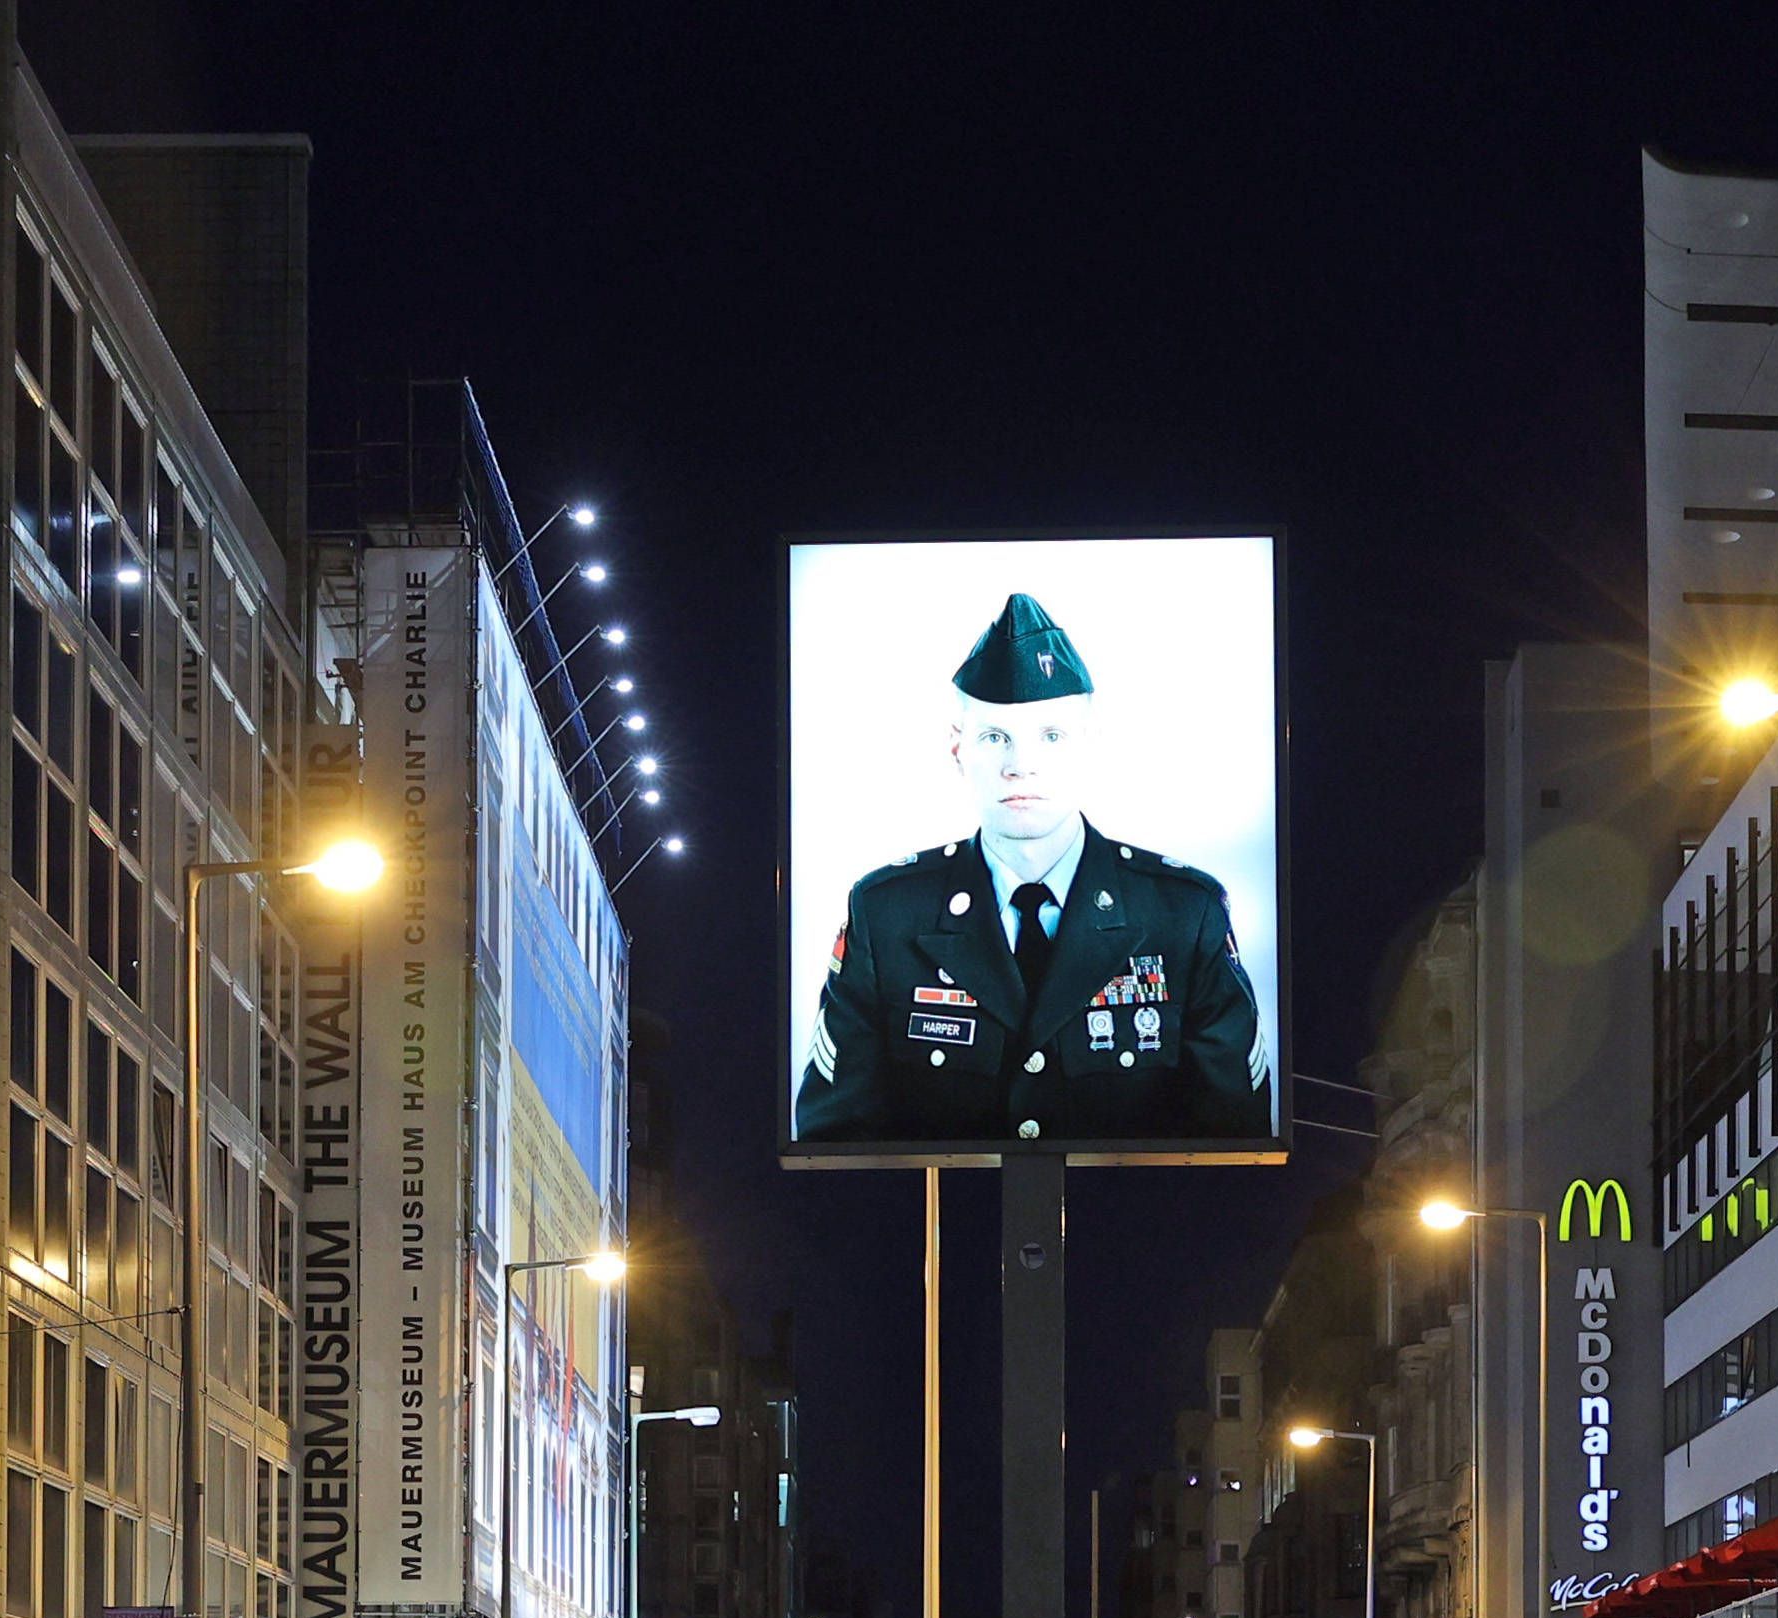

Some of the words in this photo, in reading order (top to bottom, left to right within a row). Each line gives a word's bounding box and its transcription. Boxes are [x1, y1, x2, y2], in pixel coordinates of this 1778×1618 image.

[404, 571, 426, 714] CHARLIE
[404, 729, 425, 945] CHECKPOINT
[304, 953, 351, 1091] WALL
[404, 962, 425, 1008] AM
[921, 1020, 961, 1037] HARPER
[403, 1022, 424, 1111] HAUS
[303, 1106, 350, 1192] THE
[402, 1127, 423, 1270] MUSEUM
[402, 1316, 423, 1581] MAUERMUSEUM
